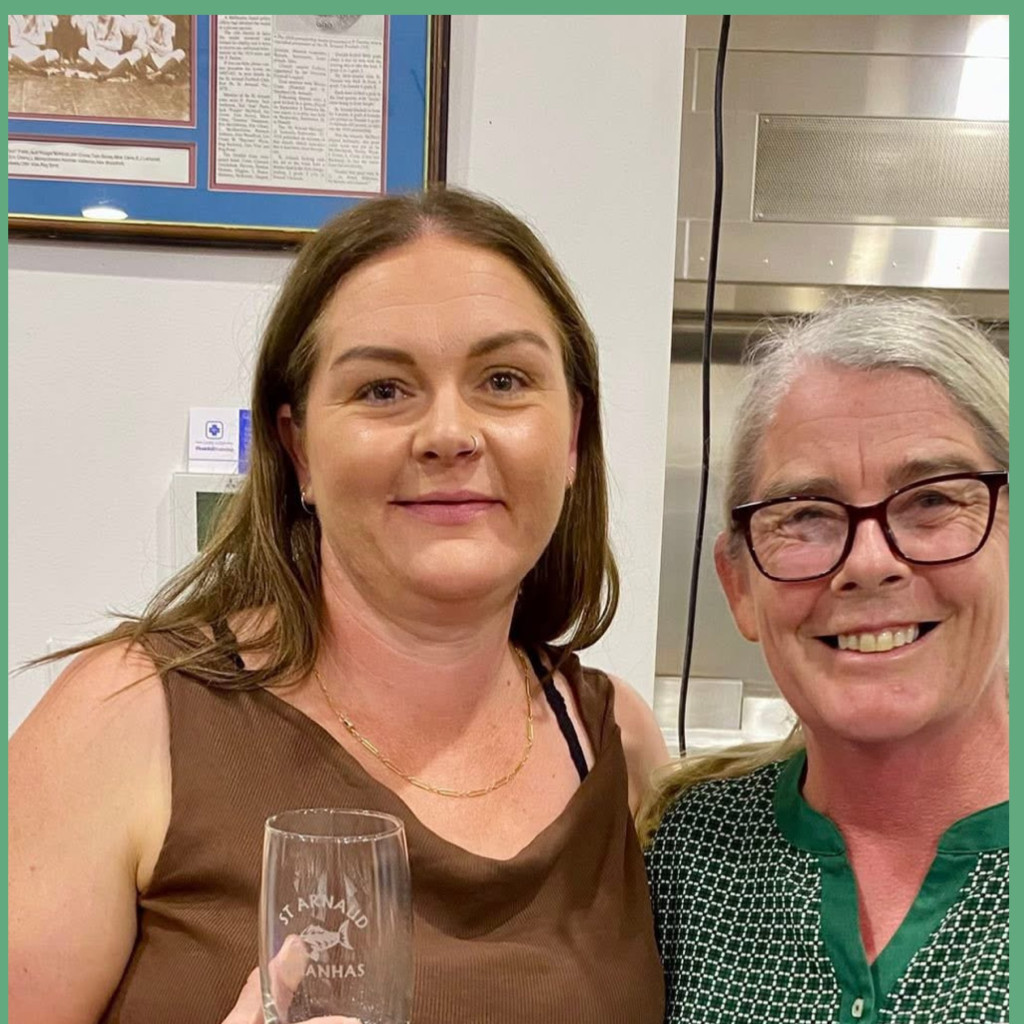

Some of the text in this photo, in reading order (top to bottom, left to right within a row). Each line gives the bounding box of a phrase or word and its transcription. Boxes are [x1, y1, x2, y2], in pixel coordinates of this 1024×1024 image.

[278, 894, 369, 929] ST ARNAUD
[305, 963, 366, 979] ANHAS
